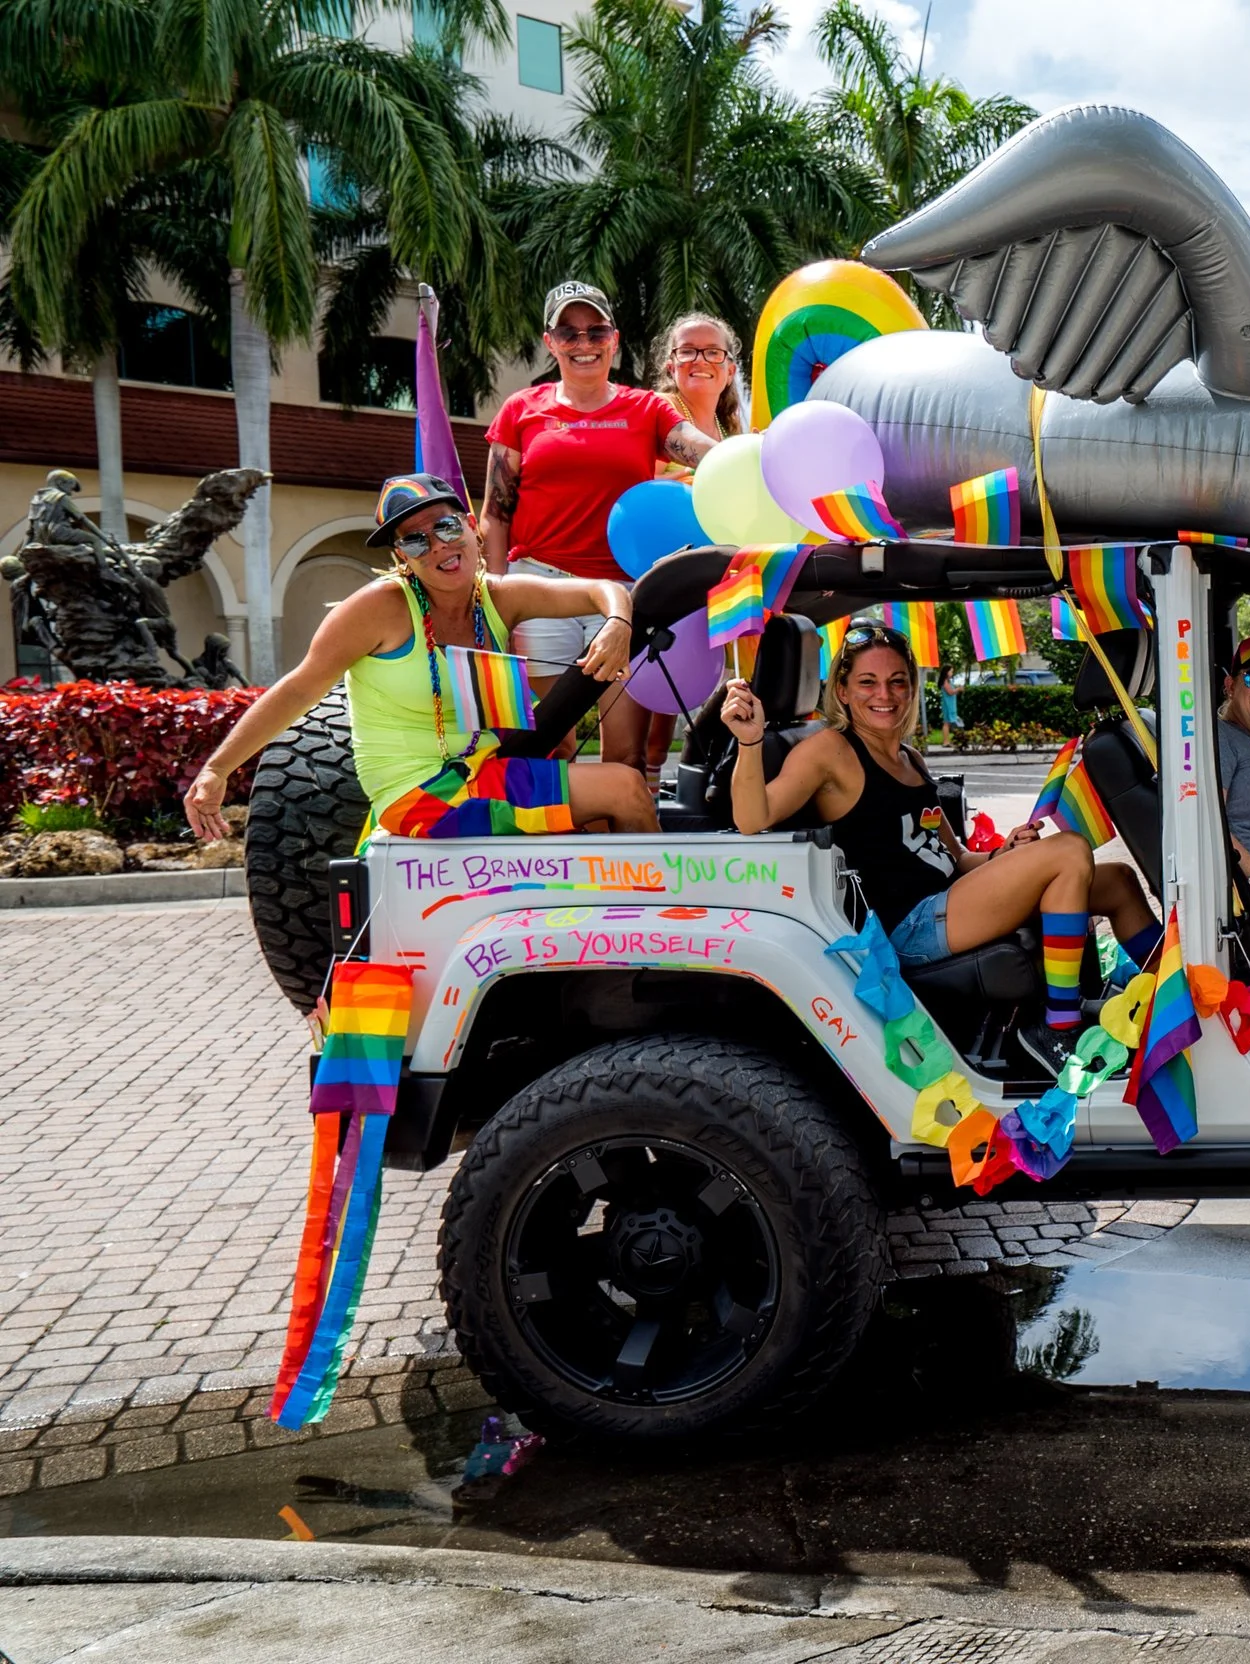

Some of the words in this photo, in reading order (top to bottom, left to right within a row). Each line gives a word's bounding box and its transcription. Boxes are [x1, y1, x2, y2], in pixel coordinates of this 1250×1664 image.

[397, 857, 452, 890] THE
[579, 856, 664, 886] THING
[663, 851, 717, 894] YOU
[724, 857, 778, 884] CAN
[464, 939, 511, 978] BE
[523, 932, 559, 960] IS
[568, 929, 736, 964] YOURSELF!
[811, 996, 858, 1048] GAY
